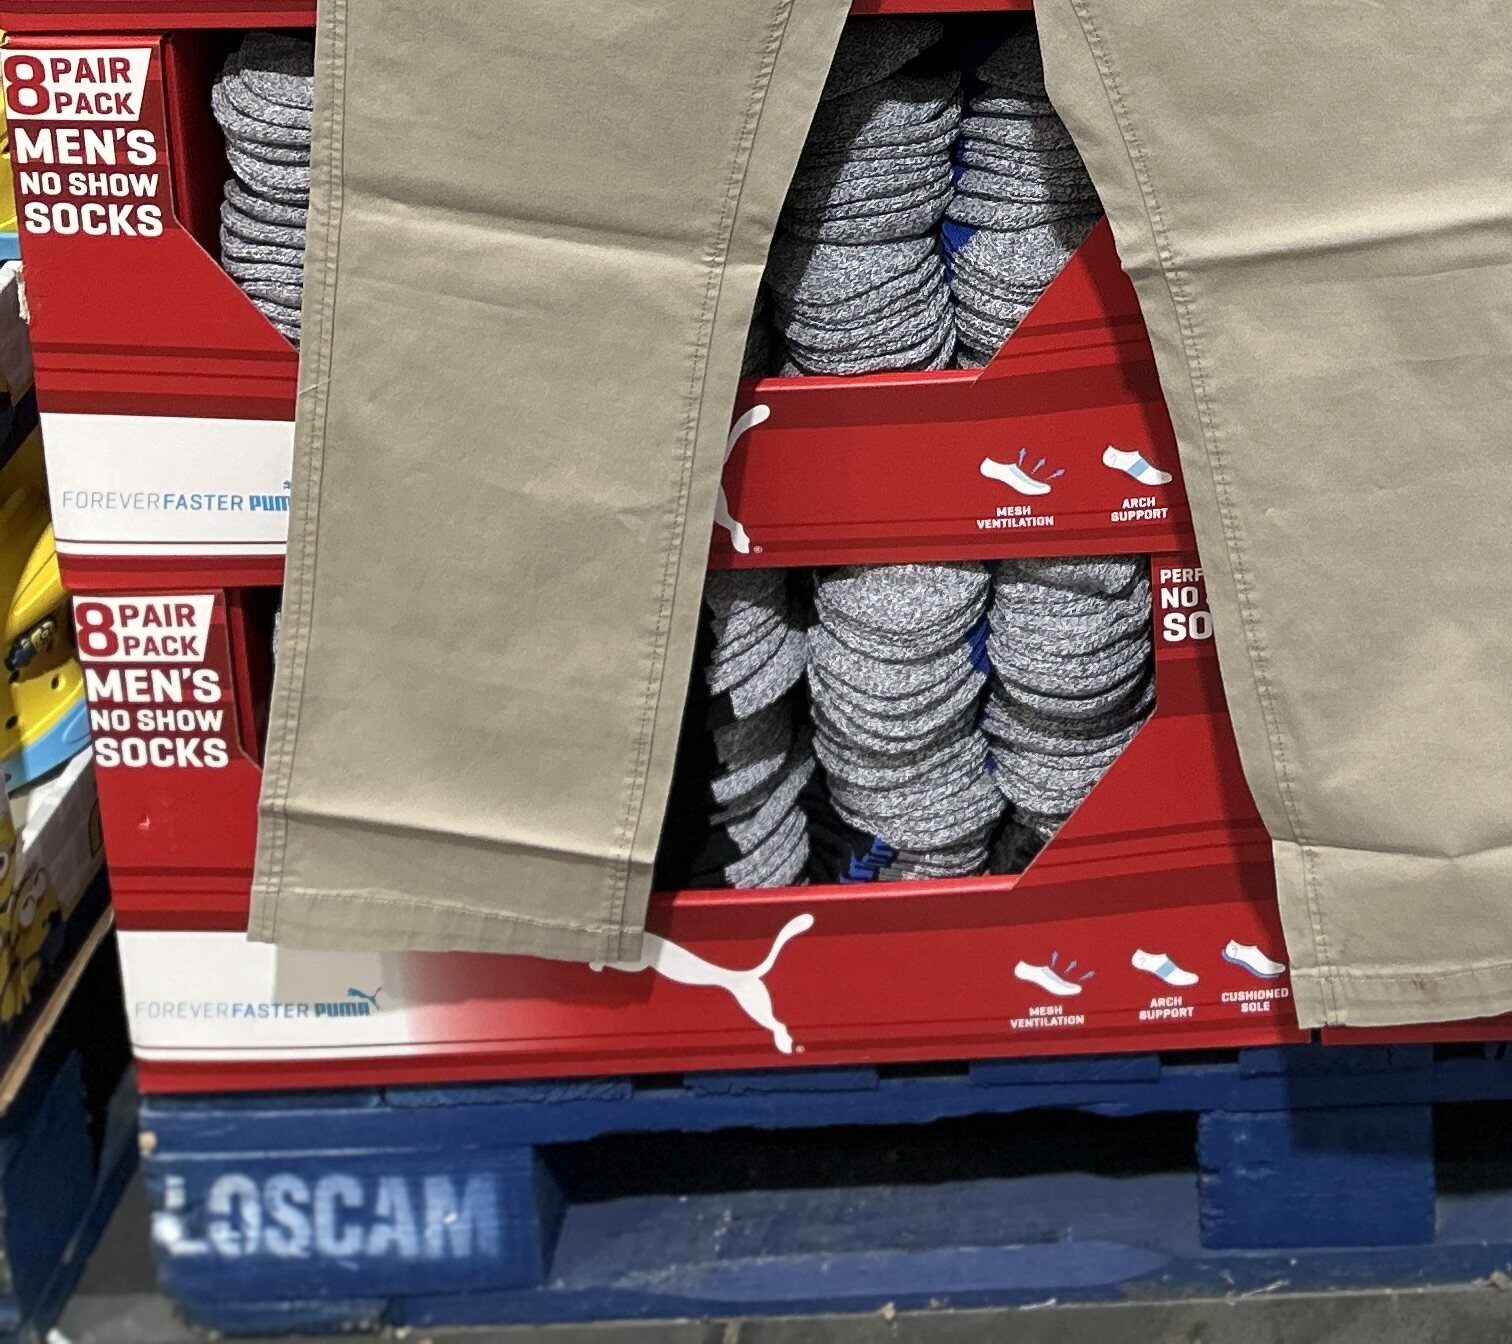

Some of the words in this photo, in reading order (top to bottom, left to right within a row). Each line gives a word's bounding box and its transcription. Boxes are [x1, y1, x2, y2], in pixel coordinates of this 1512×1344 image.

[4, 55, 50, 115] 8
[50, 57, 131, 83] PAIR
[54, 92, 135, 115] PACK
[14, 127, 157, 166] MEN'S
[20, 171, 61, 195] NO
[68, 172, 159, 197] SHOW
[24, 201, 163, 237] SOCKS
[249, 495, 290, 511] PUM
[997, 505, 1031, 516] MESH
[1122, 497, 1156, 509] ARCH
[977, 516, 1054, 529] VENTILATION
[1111, 508, 1168, 522] SUPPORT
[1160, 586, 1198, 609] NO
[75, 602, 119, 657] 8
[118, 603, 196, 628] PAIR
[122, 635, 199, 656] PACK
[85, 668, 222, 703] MEN'S
[90, 710, 131, 731] NO
[137, 709, 224, 732] SHOW
[94, 737, 229, 768] SOCKS
[1150, 996, 1182, 1008] ARCH
[1221, 988, 1289, 1002] CUSHIONED
[313, 1002, 370, 1017] PUMA
[1029, 1005, 1062, 1016] MESH
[1139, 1007, 1194, 1021] SUPPORT
[1241, 1001, 1270, 1013] SOLE
[1010, 1015, 1085, 1029] VENTILATION
[153, 1173, 500, 1258] LOSCAM
